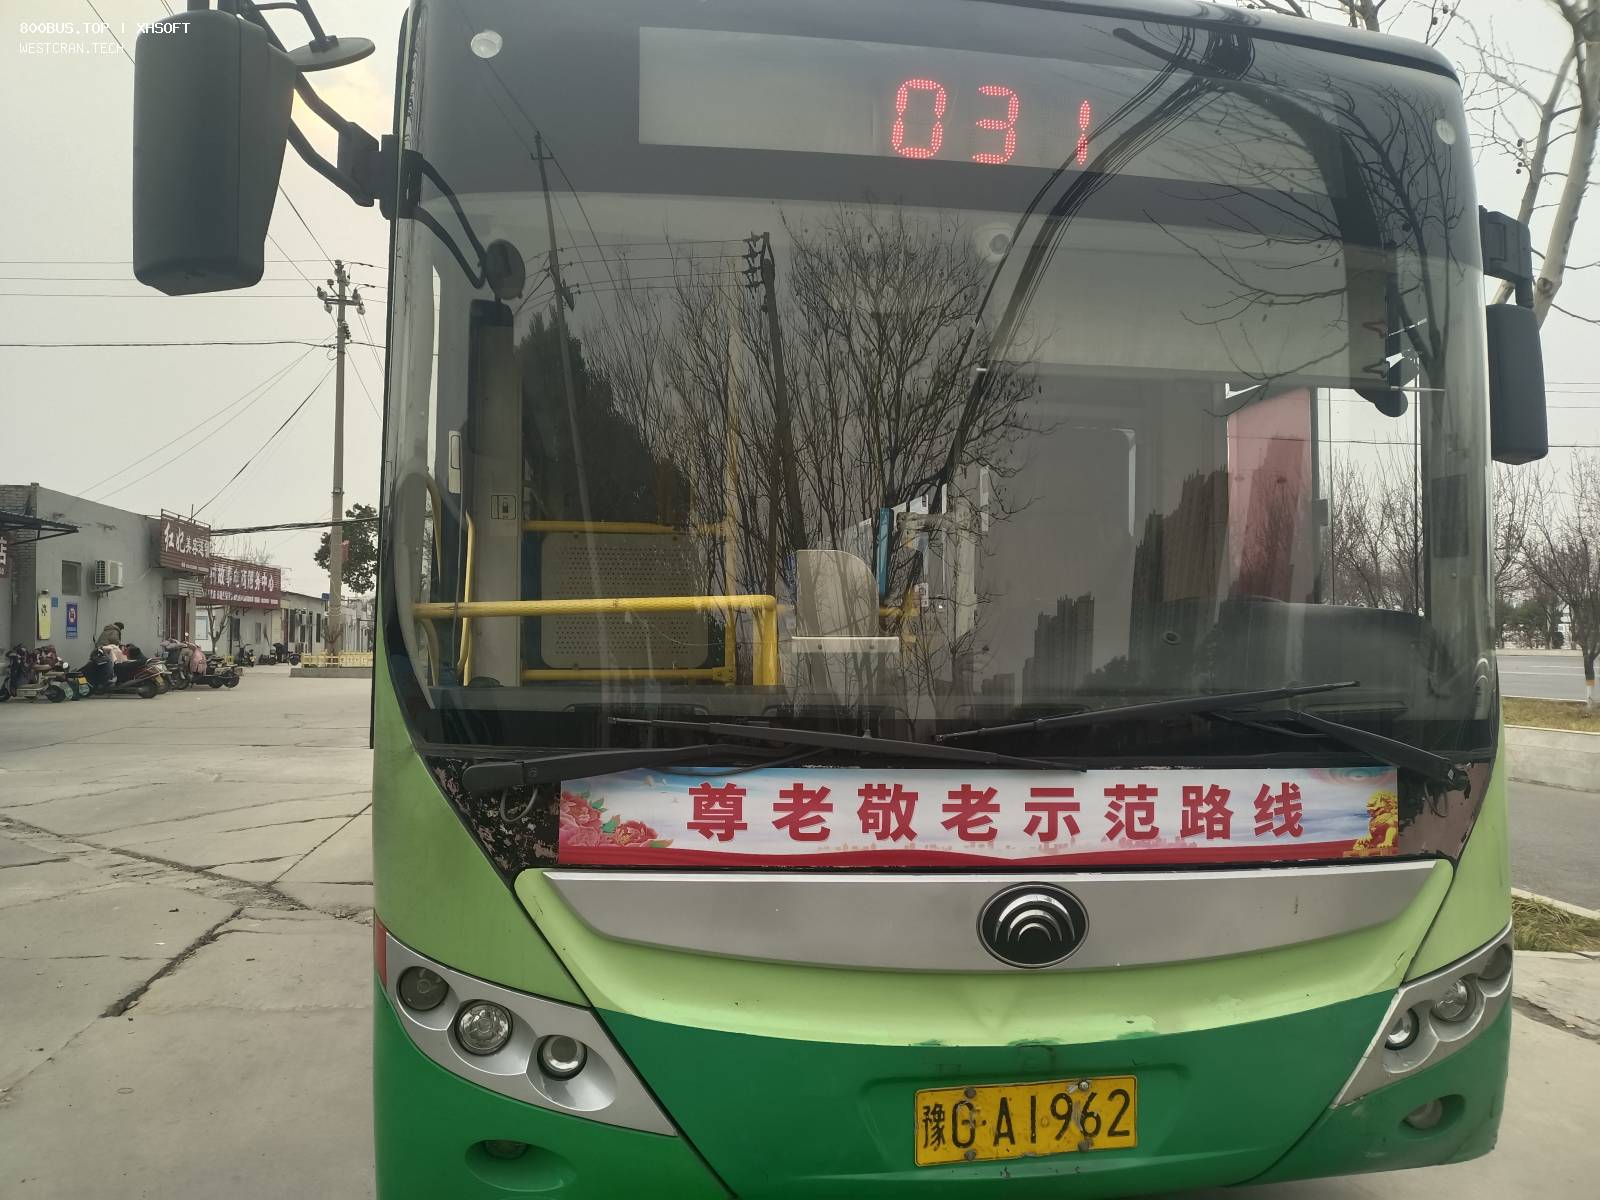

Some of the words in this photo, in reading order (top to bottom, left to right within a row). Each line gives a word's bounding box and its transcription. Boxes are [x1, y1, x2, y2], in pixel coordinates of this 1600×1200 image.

[892, 78, 1091, 166] 031
[686, 780, 1305, 843] 尊老敬老示范路线
